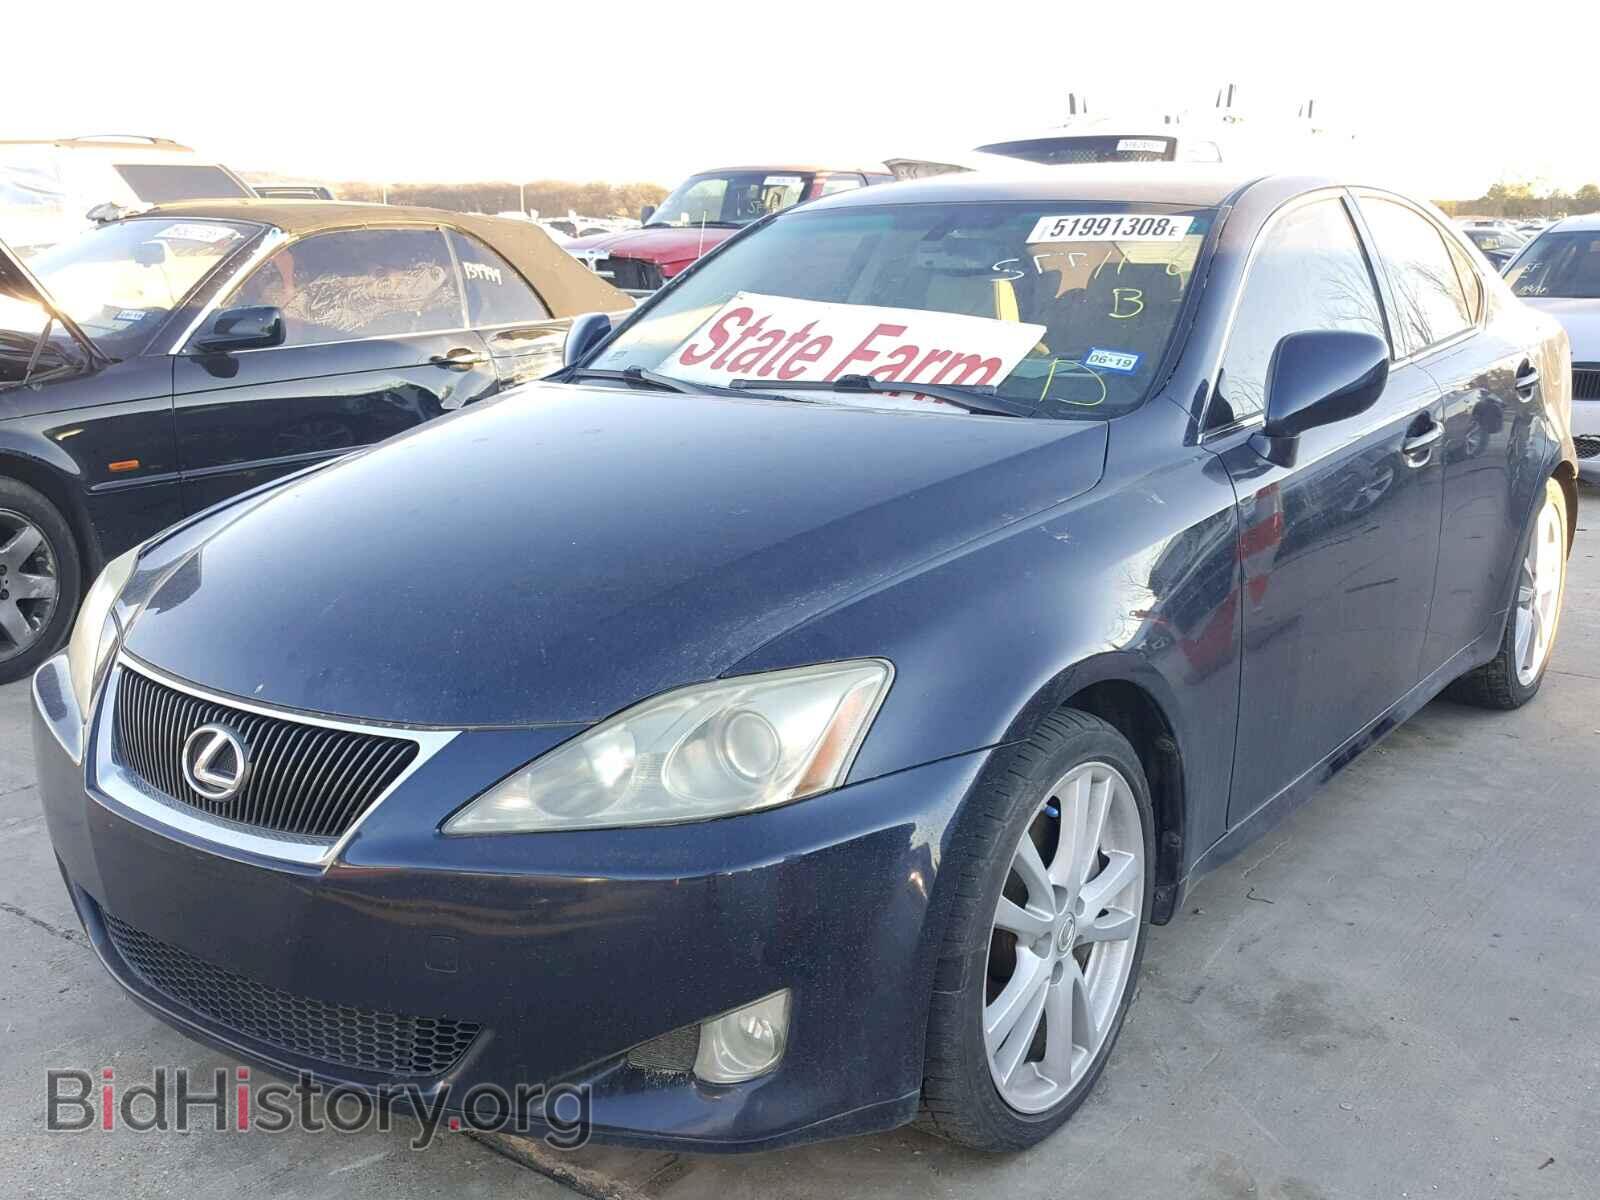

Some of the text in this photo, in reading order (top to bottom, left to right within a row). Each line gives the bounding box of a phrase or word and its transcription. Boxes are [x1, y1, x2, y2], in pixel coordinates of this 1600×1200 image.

[1050, 217, 1170, 238] 51991308
[1168, 225, 1179, 237] E
[679, 306, 1003, 404] State Farm
